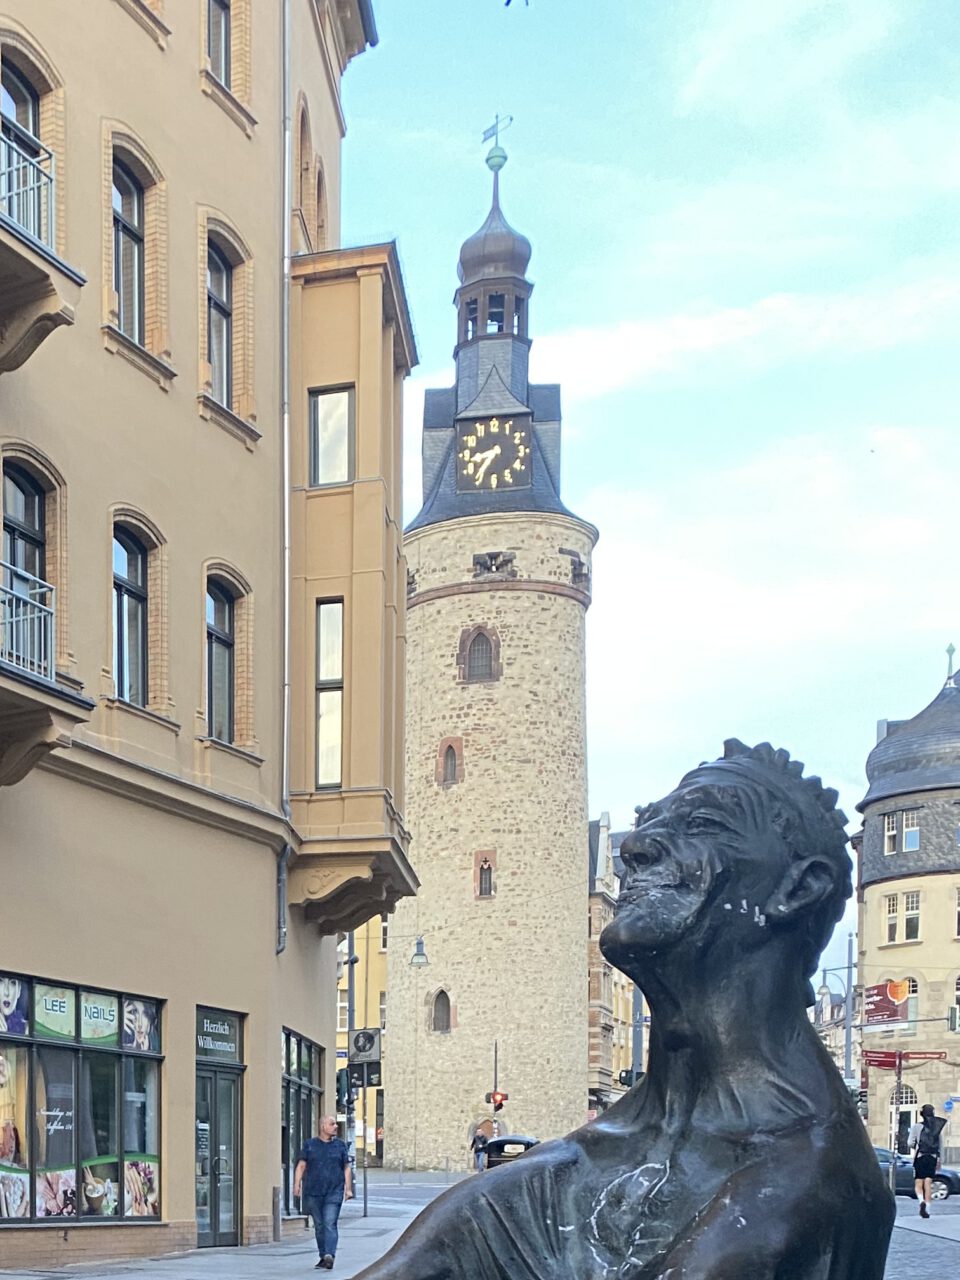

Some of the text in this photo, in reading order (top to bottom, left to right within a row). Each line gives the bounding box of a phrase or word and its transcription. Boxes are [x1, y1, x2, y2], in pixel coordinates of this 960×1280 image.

[477, 424, 485, 437] 11
[489, 420, 499, 432] 12
[467, 435, 476, 447] 10
[514, 432, 520, 444] 2
[463, 449, 470, 461] 9
[518, 445, 525, 457] 3
[512, 459, 521, 471] 4
[504, 469, 511, 481] 5
[44, 998, 66, 1014] LEE
[203, 1019, 230, 1035] Herzlich
[197, 1035, 236, 1052] Willkommen
